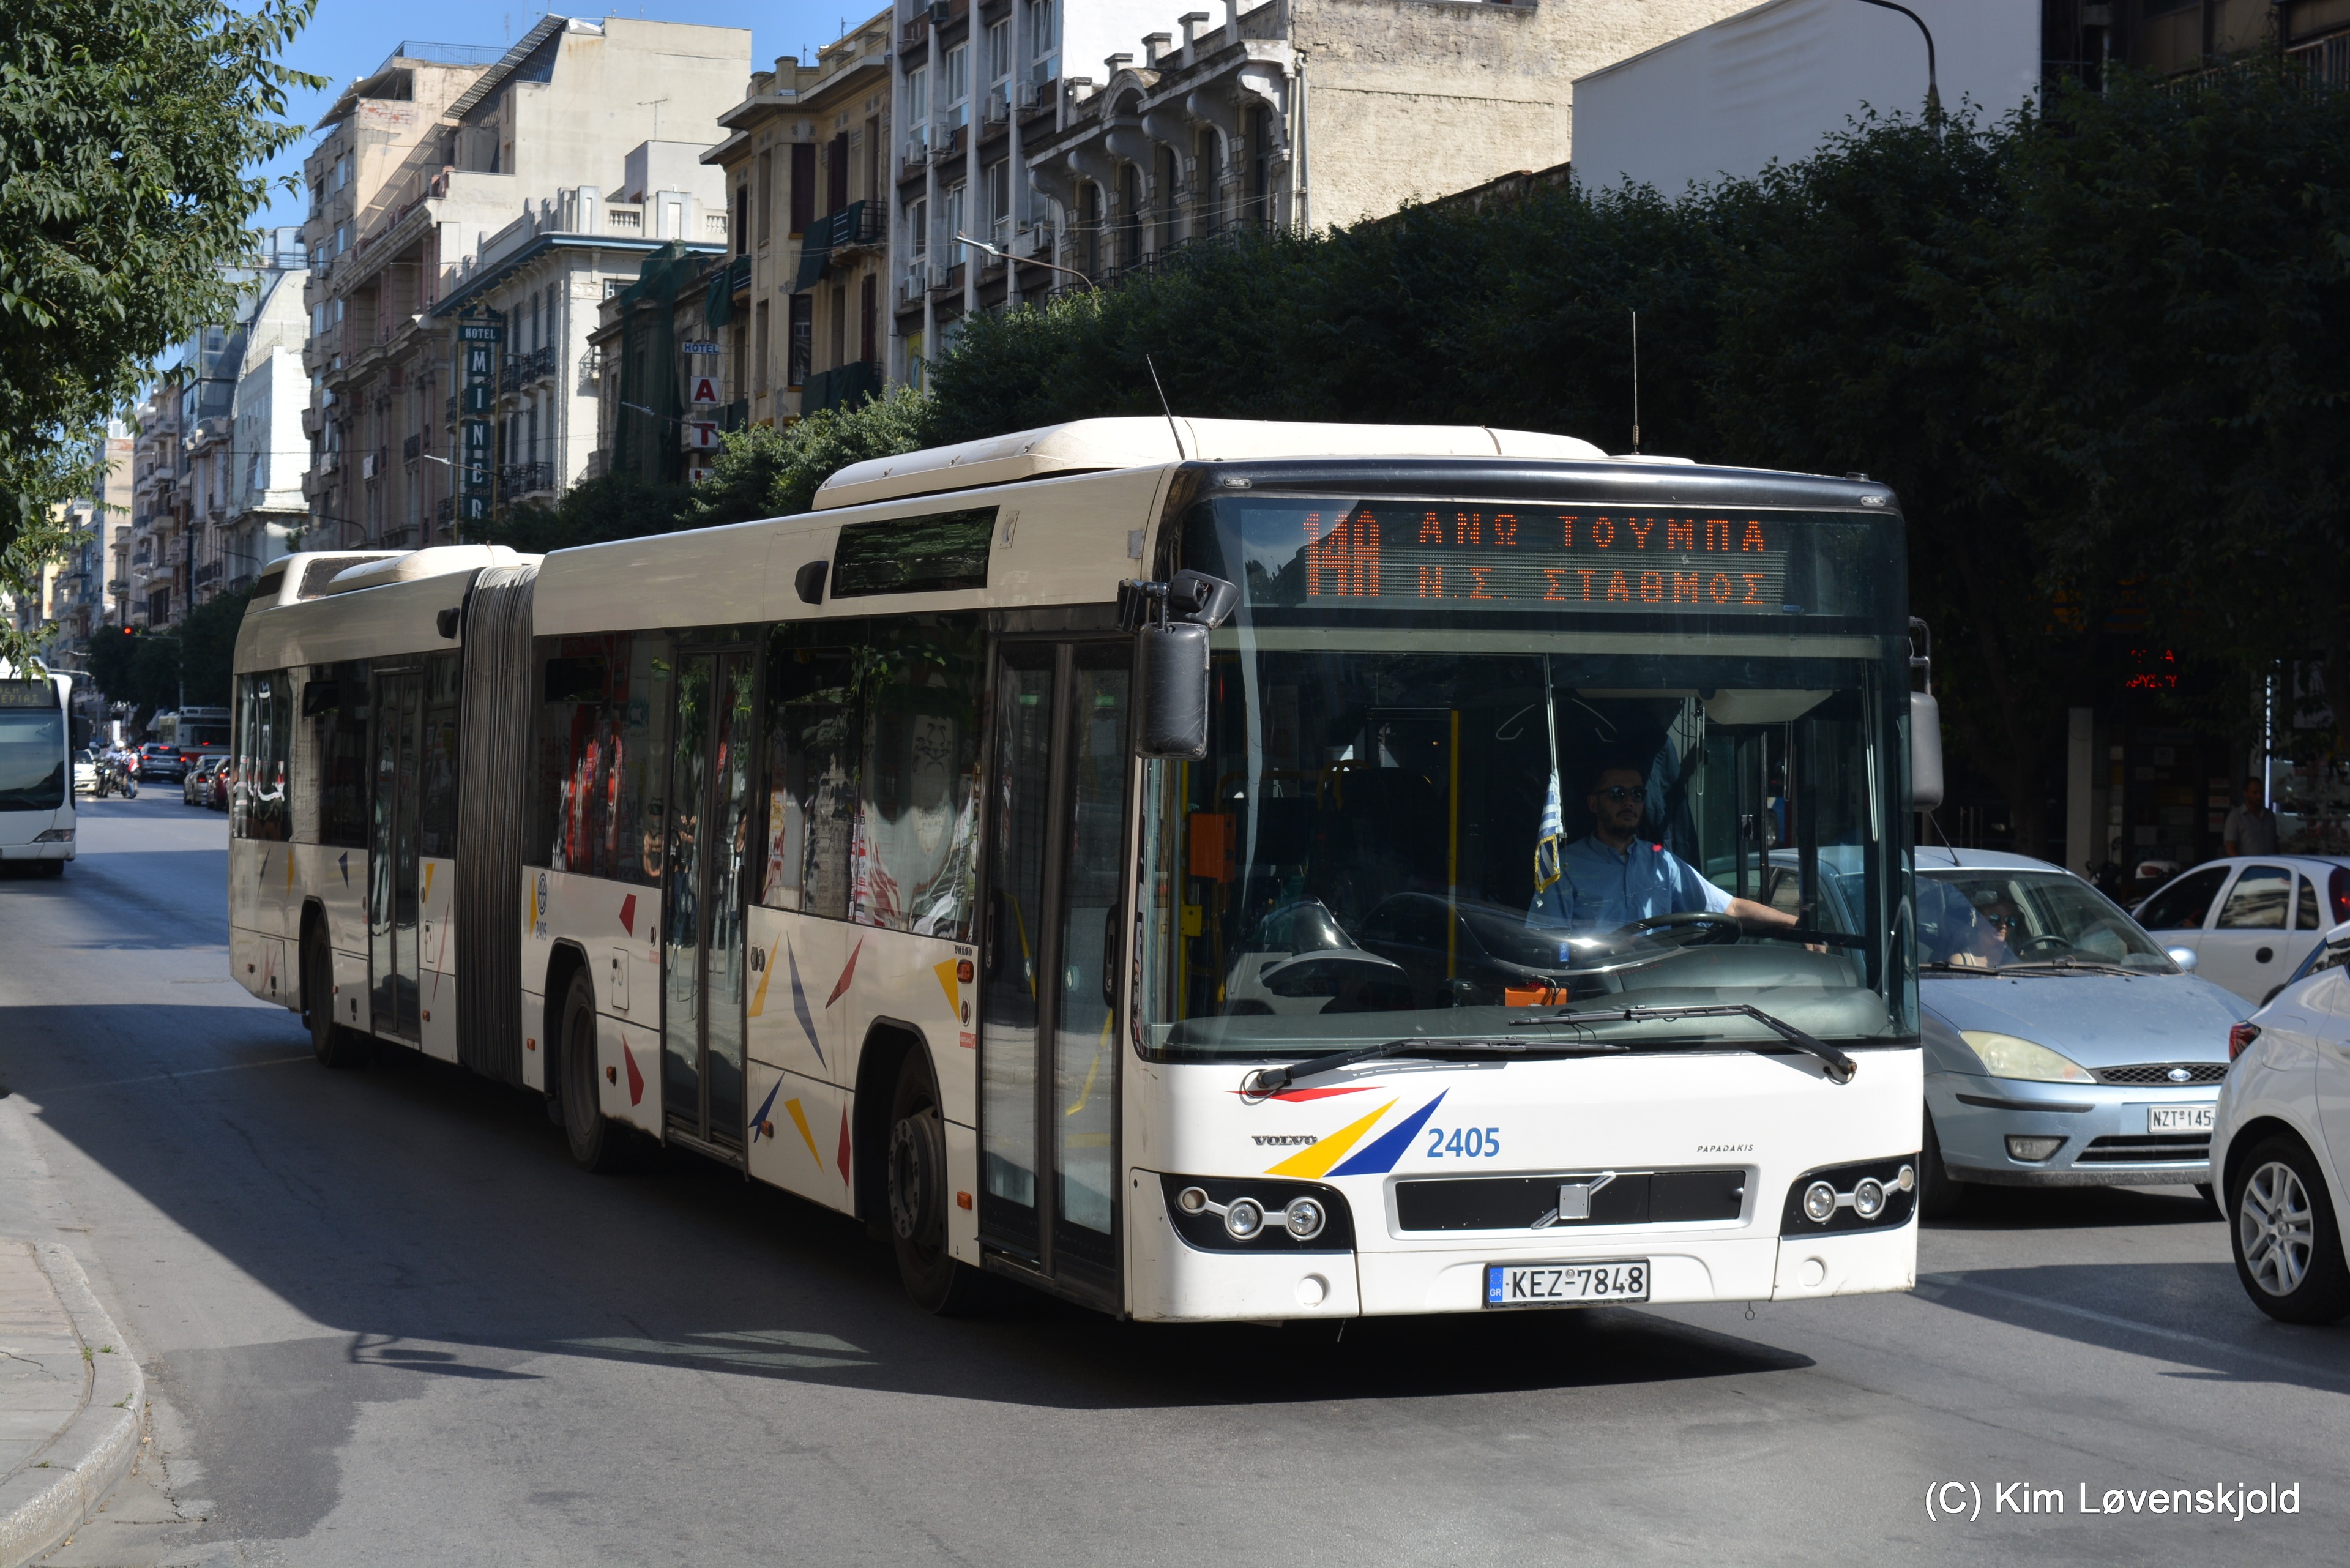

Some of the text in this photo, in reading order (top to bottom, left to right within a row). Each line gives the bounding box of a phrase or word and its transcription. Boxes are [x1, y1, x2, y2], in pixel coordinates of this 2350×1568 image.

[465, 327, 496, 340] HOTEL
[684, 343, 718, 354] HOTEL
[693, 378, 717, 480] AT
[1419, 512, 1765, 551] ΑΝΩ ΤΟΥΜΠΑ
[1543, 569, 1765, 605] ΣΤΑΘΜΟΣ
[954, 944, 972, 956] VOLVO
[2153, 1110, 2212, 1127] NZT-145
[1251, 1135, 1318, 1146] VOLVO
[1427, 1127, 1500, 1159] 2405
[1697, 1144, 1754, 1152] PAPADAKIS
[1490, 1288, 1502, 1297] GR
